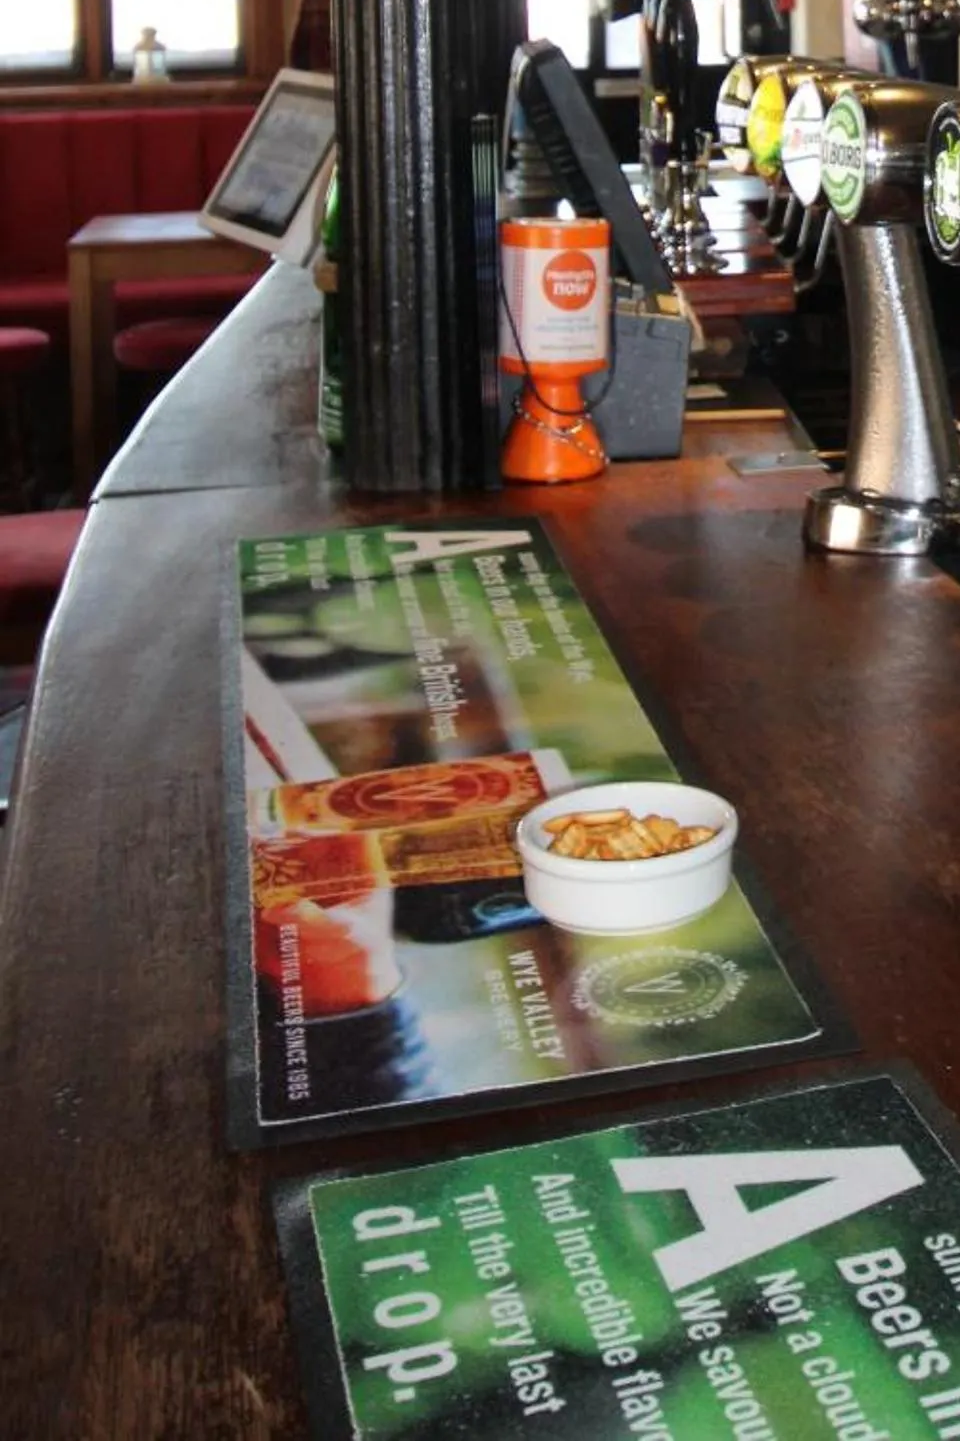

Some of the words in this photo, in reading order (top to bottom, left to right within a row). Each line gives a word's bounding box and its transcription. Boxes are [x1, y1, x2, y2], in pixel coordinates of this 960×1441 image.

[384, 531, 532, 563] A
[420, 663, 468, 711] British
[280, 923, 301, 985] BEAUTIFUL
[508, 950, 544, 989] WYE
[282, 985, 304, 1026] BEERS
[521, 991, 566, 1058] VALLEY
[285, 1026, 308, 1066] SINCE
[287, 1067, 311, 1101] 1985
[453, 1184, 506, 1231] Till
[531, 1173, 591, 1224] And
[606, 1144, 926, 1293] A
[468, 1231, 514, 1281] the
[485, 1280, 537, 1347] very
[553, 1224, 643, 1368] incredible
[673, 1286, 729, 1342] We
[755, 1268, 815, 1325] Not
[835, 1247, 951, 1381] Beers
[786, 1330, 823, 1354] a
[507, 1350, 567, 1417] last
[699, 1345, 778, 1441] savou
[802, 1355, 891, 1441] cloud
